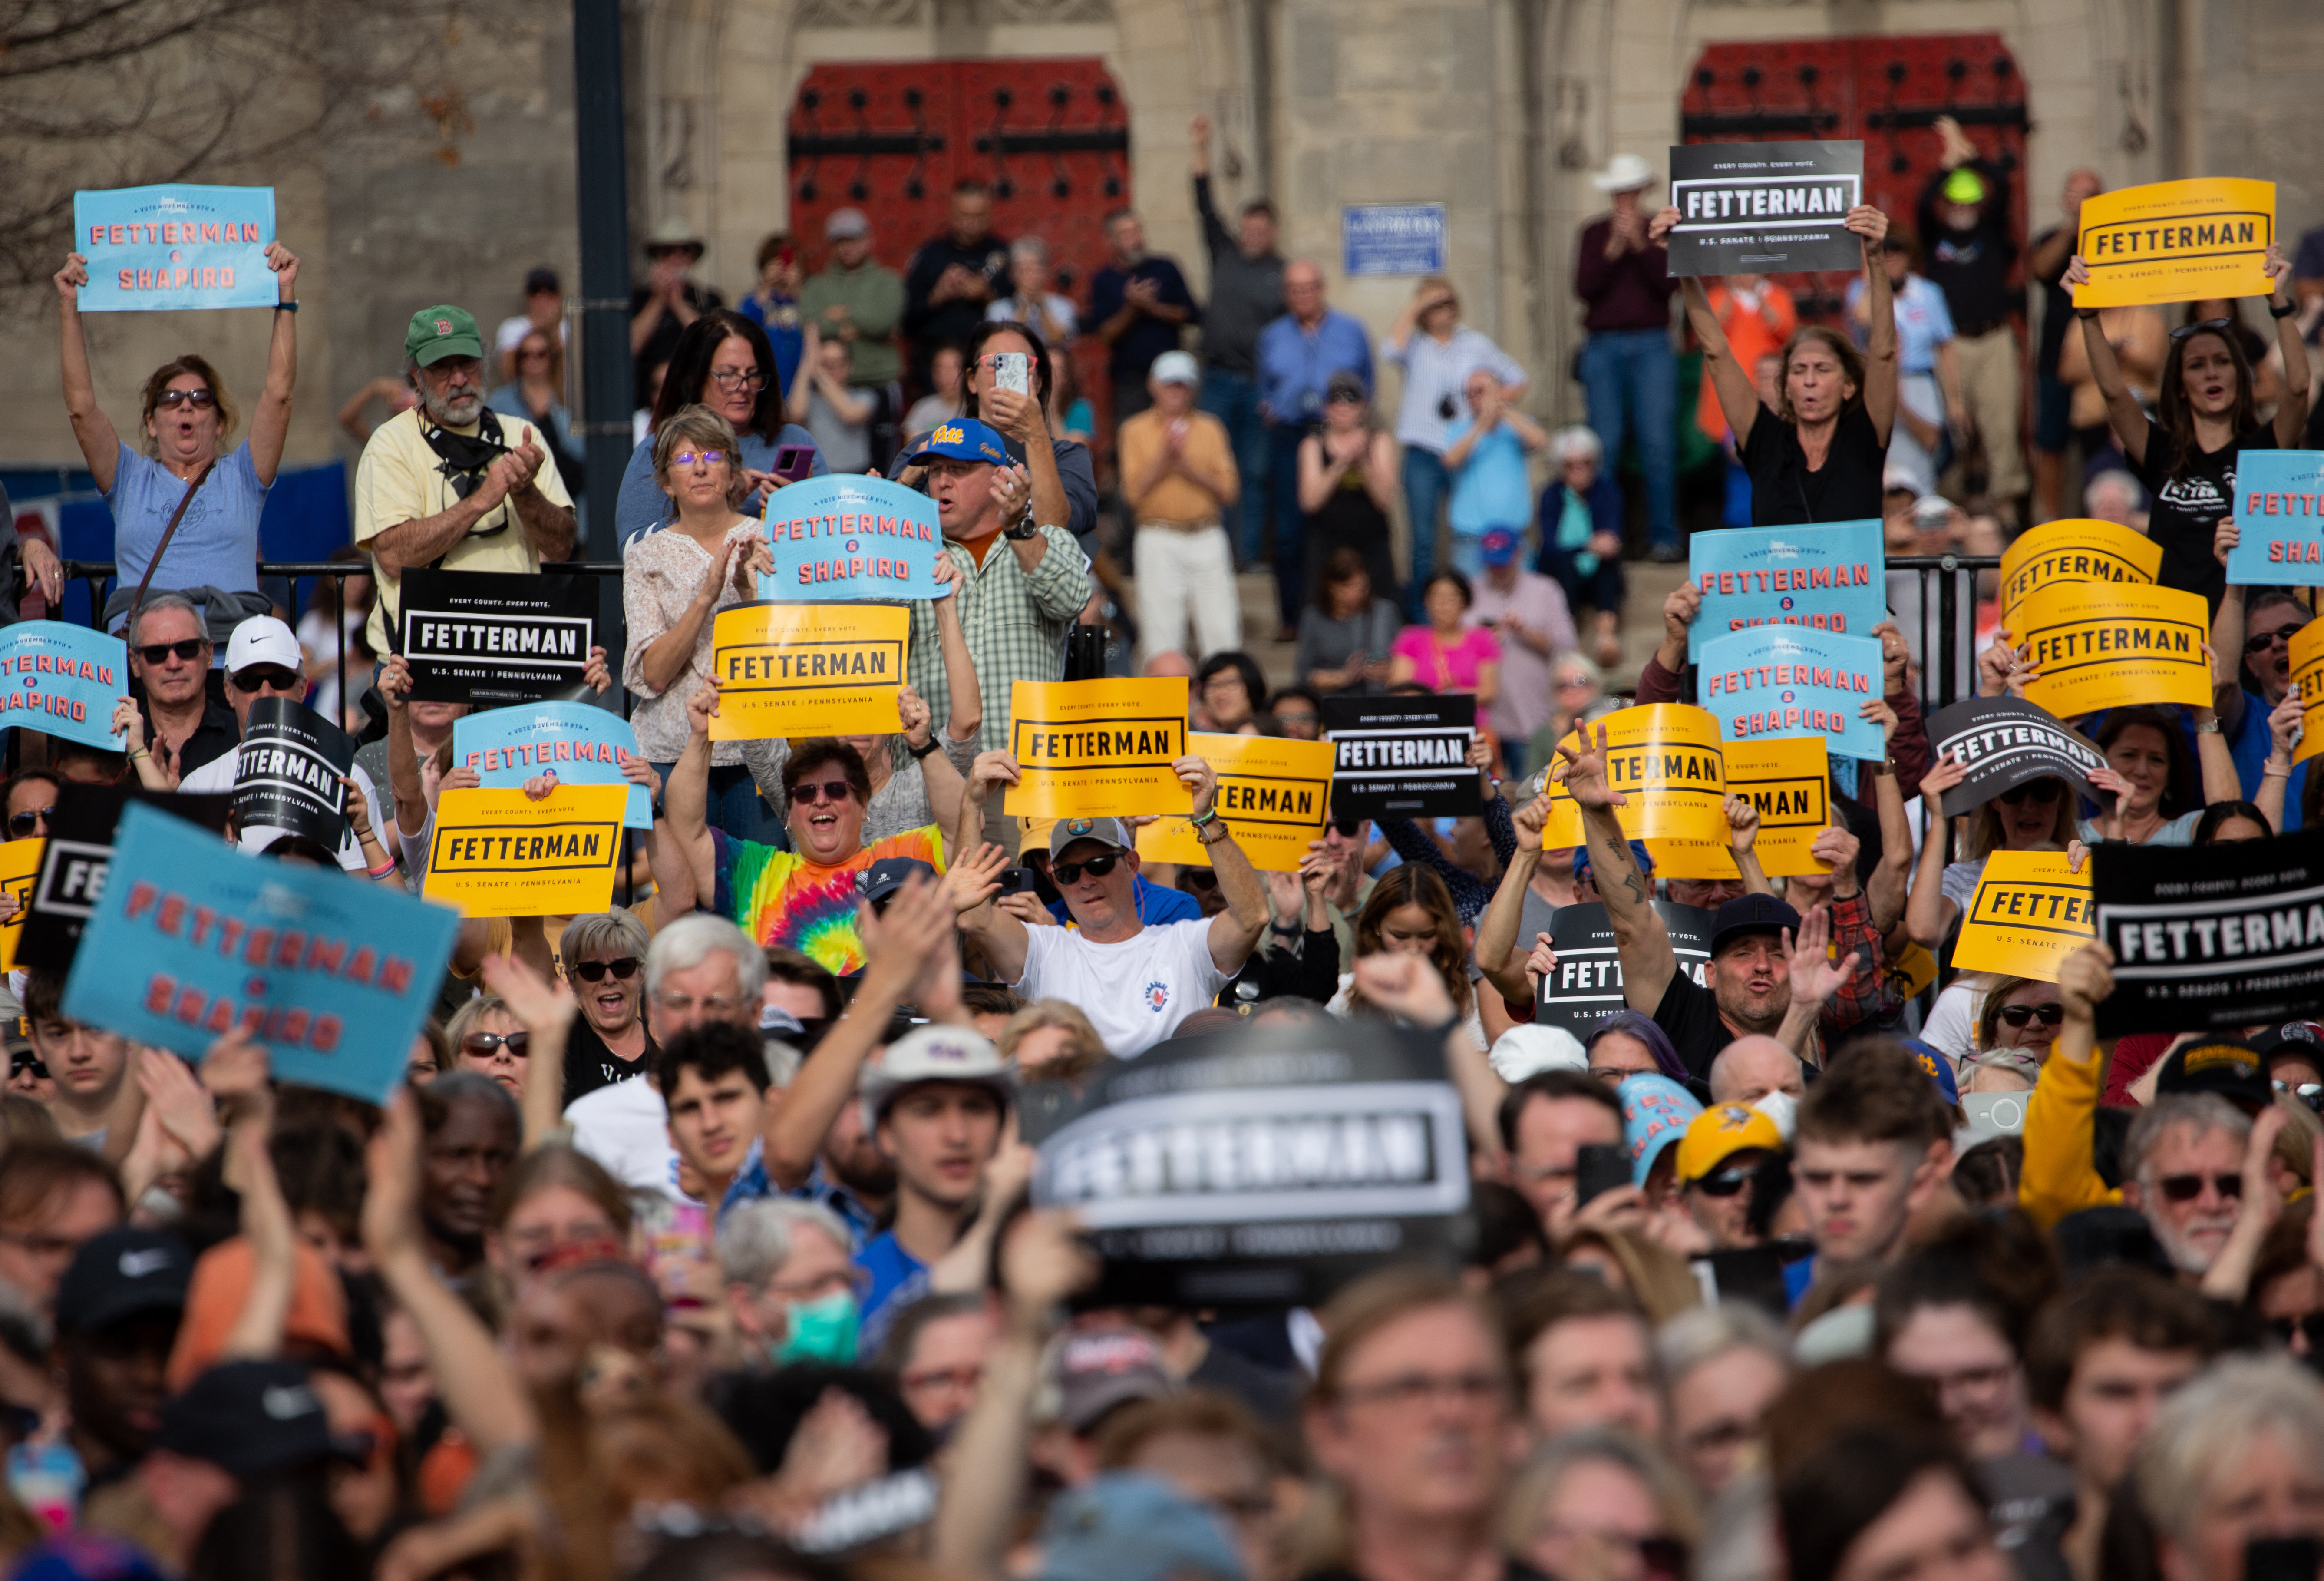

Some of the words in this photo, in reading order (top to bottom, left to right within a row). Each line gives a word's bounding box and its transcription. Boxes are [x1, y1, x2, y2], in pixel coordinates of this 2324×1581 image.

[1687, 187, 1843, 218] FETTERMAN
[91, 222, 258, 244] FETTERMAN
[1720, 236, 1755, 245] SENATE
[1764, 233, 1829, 244] PENNSYLVANIA
[2096, 222, 2254, 255] FETTERMAN
[119, 267, 234, 290] SHAPIRO
[2129, 269, 2164, 278] SENATE
[2174, 263, 2240, 273] PENNSYLVANIA
[434, 319, 452, 336] B
[932, 425, 964, 445] Pitt
[1005, 452, 1019, 465] VER
[773, 513, 933, 542] FETTERMAN
[799, 557, 909, 584] SHAPIRO
[1700, 563, 1868, 594] FETTERMAN
[421, 623, 575, 655] FETTERMAN
[2038, 628, 2189, 664] FETTERMAN
[1, 654, 113, 685] TERMAN
[453, 668, 486, 678] SENATE
[497, 671, 561, 681] PENNSYLVANIA
[729, 652, 885, 680] FETTERMAN
[1710, 664, 1868, 696] FETTERMAN
[2069, 673, 2099, 686] SENATE
[0, 692, 86, 721] HAPIRO
[808, 696, 873, 705] PENNSYLVANIA
[514, 725, 531, 734] VOTE
[1734, 708, 1844, 737] SHAPIRO
[2029, 714, 2048, 724] EVERY
[279, 725, 301, 735] EVERY
[303, 732, 319, 745] VOTE.
[1031, 730, 1169, 757] FETTERMAN
[1951, 727, 2097, 767] FETTERMAN
[466, 741, 630, 771] FETTERMAN
[1340, 739, 1464, 767] FETTERMAN
[1990, 756, 2022, 773] SENATE
[235, 749, 332, 796] ETTERMAN
[1611, 755, 1717, 782] TERMAN
[1095, 777, 1159, 786] PENNSYLVANIA
[239, 793, 253, 804] SENATE
[260, 792, 318, 814] PENNSYLVANIA
[1213, 784, 1312, 814] TERMAN
[449, 833, 600, 861] FETTERMAN
[1235, 831, 1297, 841] PENNSYLVANIA
[1753, 837, 1797, 846] NSYLVANIA
[521, 878, 581, 886] PENNSYLVANIA
[876, 876, 890, 885] VIKING
[1991, 892, 2096, 925] FETTER
[1679, 933, 1700, 941] VOTE.
[2020, 938, 2057, 949] SENATE
[2119, 903, 2324, 962] FETTERMA
